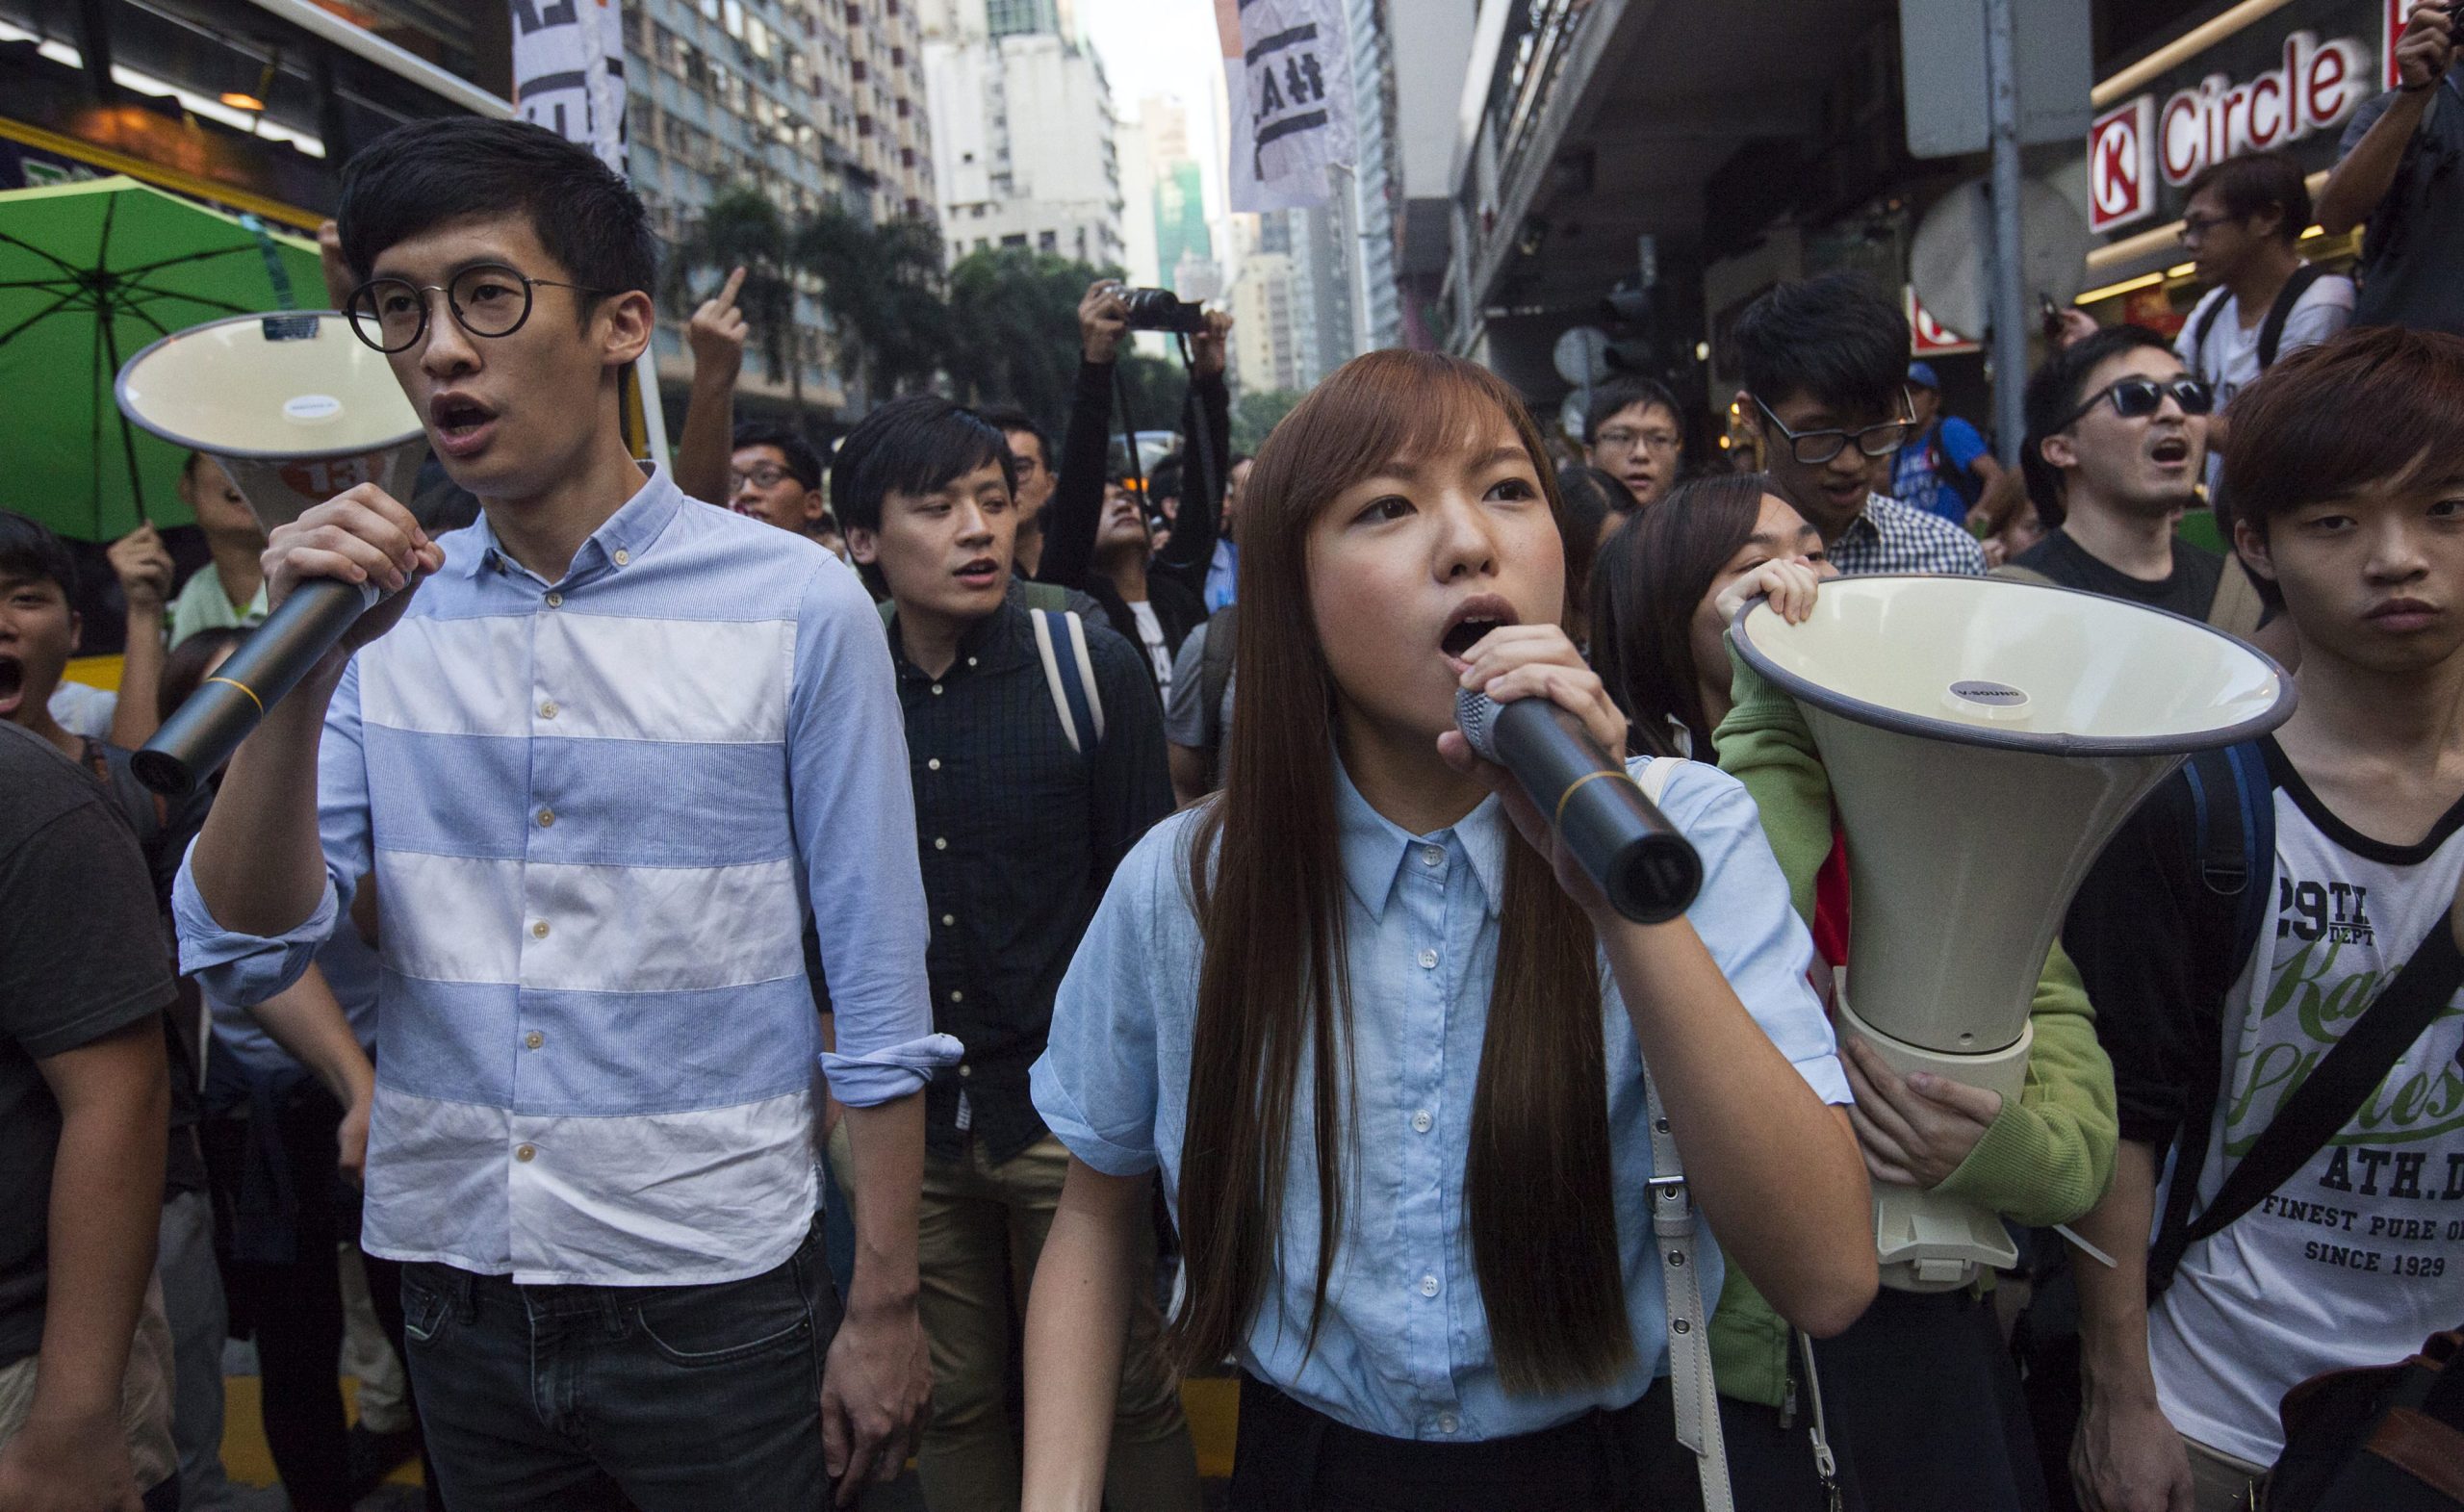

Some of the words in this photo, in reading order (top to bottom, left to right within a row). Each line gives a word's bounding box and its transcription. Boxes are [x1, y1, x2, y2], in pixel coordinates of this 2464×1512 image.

[2160, 35, 2354, 184] Circle
[2263, 1194, 2357, 1231] FINEST
[2369, 1216, 2437, 1241] PURE
[2304, 1241, 2381, 1272] SINCE
[2392, 1254, 2446, 1277] 1929
